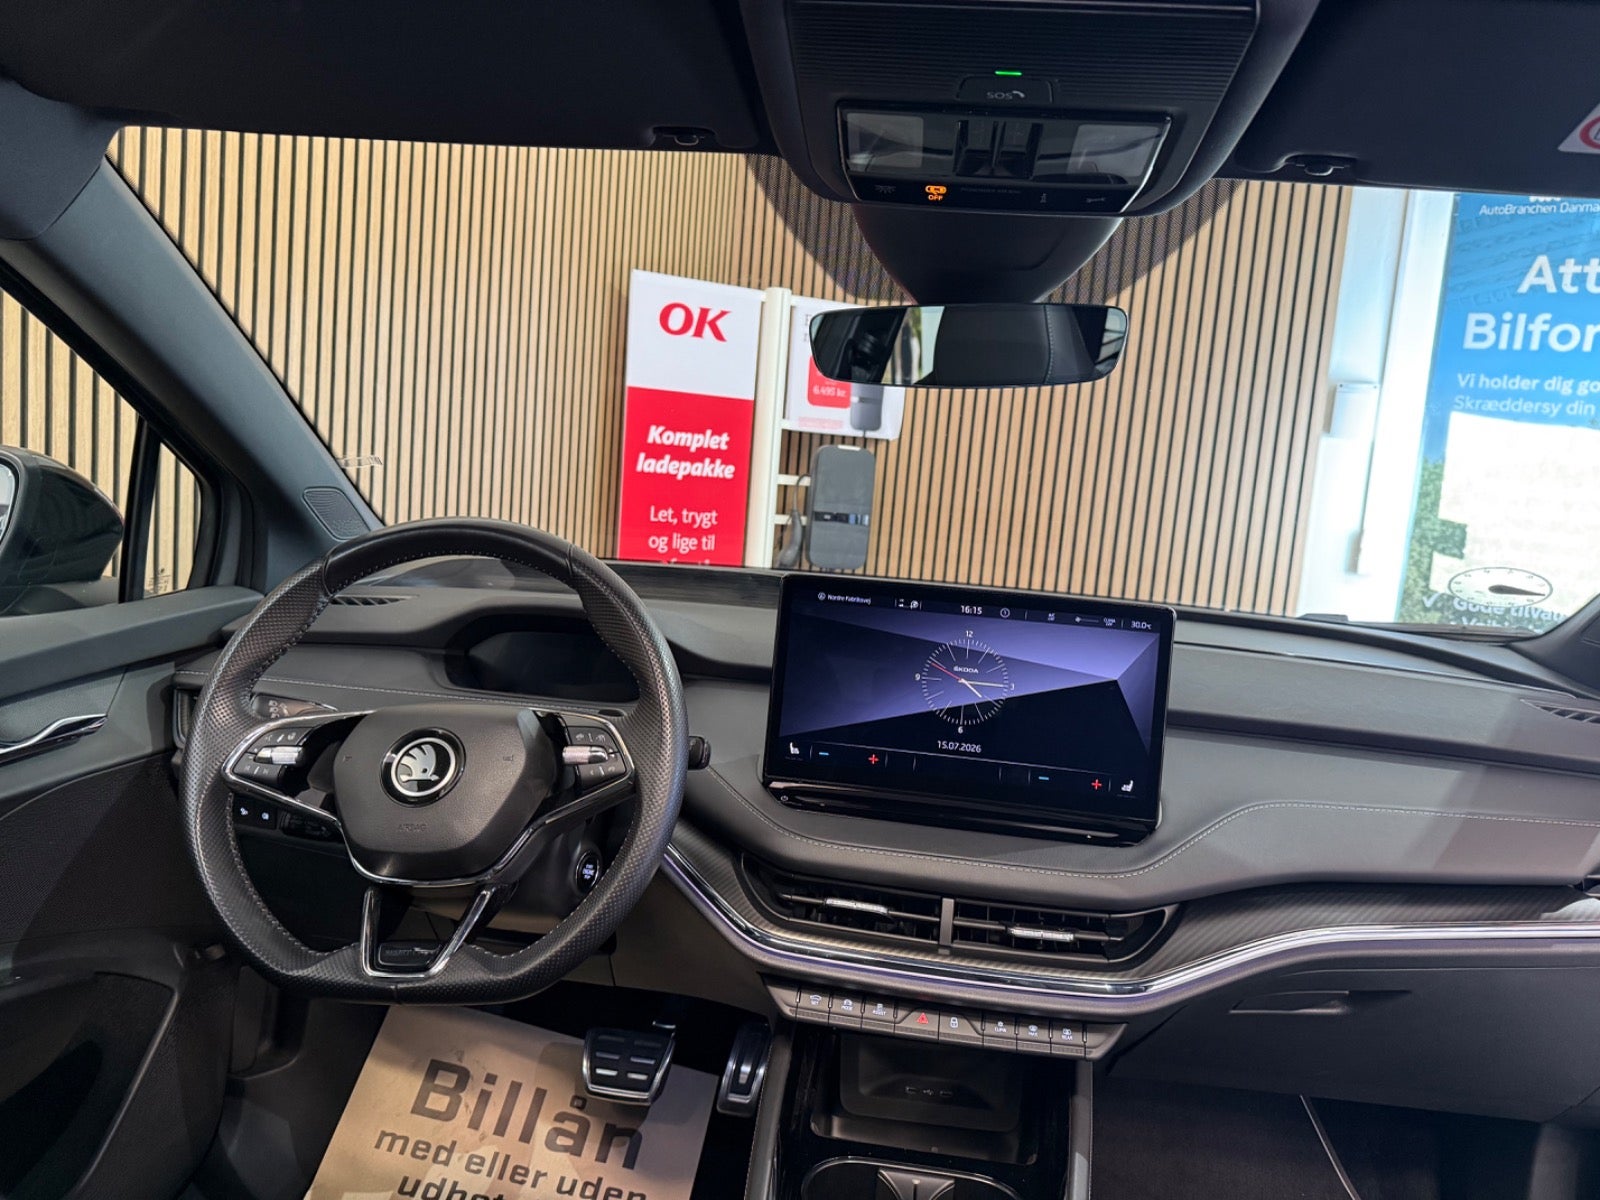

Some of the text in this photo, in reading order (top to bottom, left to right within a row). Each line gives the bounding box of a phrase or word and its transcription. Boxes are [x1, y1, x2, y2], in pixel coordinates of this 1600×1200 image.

[987, 91, 1013, 100] SOS
[1479, 201, 1600, 216] AutoBranchen Danma
[1517, 254, 1600, 294] Att
[659, 302, 732, 343] OK
[1463, 311, 1600, 352] Bilfor
[1457, 373, 1600, 397] Vi holder dig go
[1453, 395, 1596, 419] Skræddersy din
[647, 425, 730, 453] Komplet
[636, 452, 735, 480] ladepakke
[650, 505, 718, 529] Let, trygt
[648, 533, 716, 554] og lige til
[960, 605, 983, 615] 16:15
[966, 630, 974, 638] 12
[915, 673, 921, 681] 9
[958, 726, 964, 734] 6
[937, 740, 982, 753] 15.07.2026
[410, 1059, 643, 1170] Billån
[375, 1129, 456, 1167] med
[464, 1154, 548, 1190] eller
